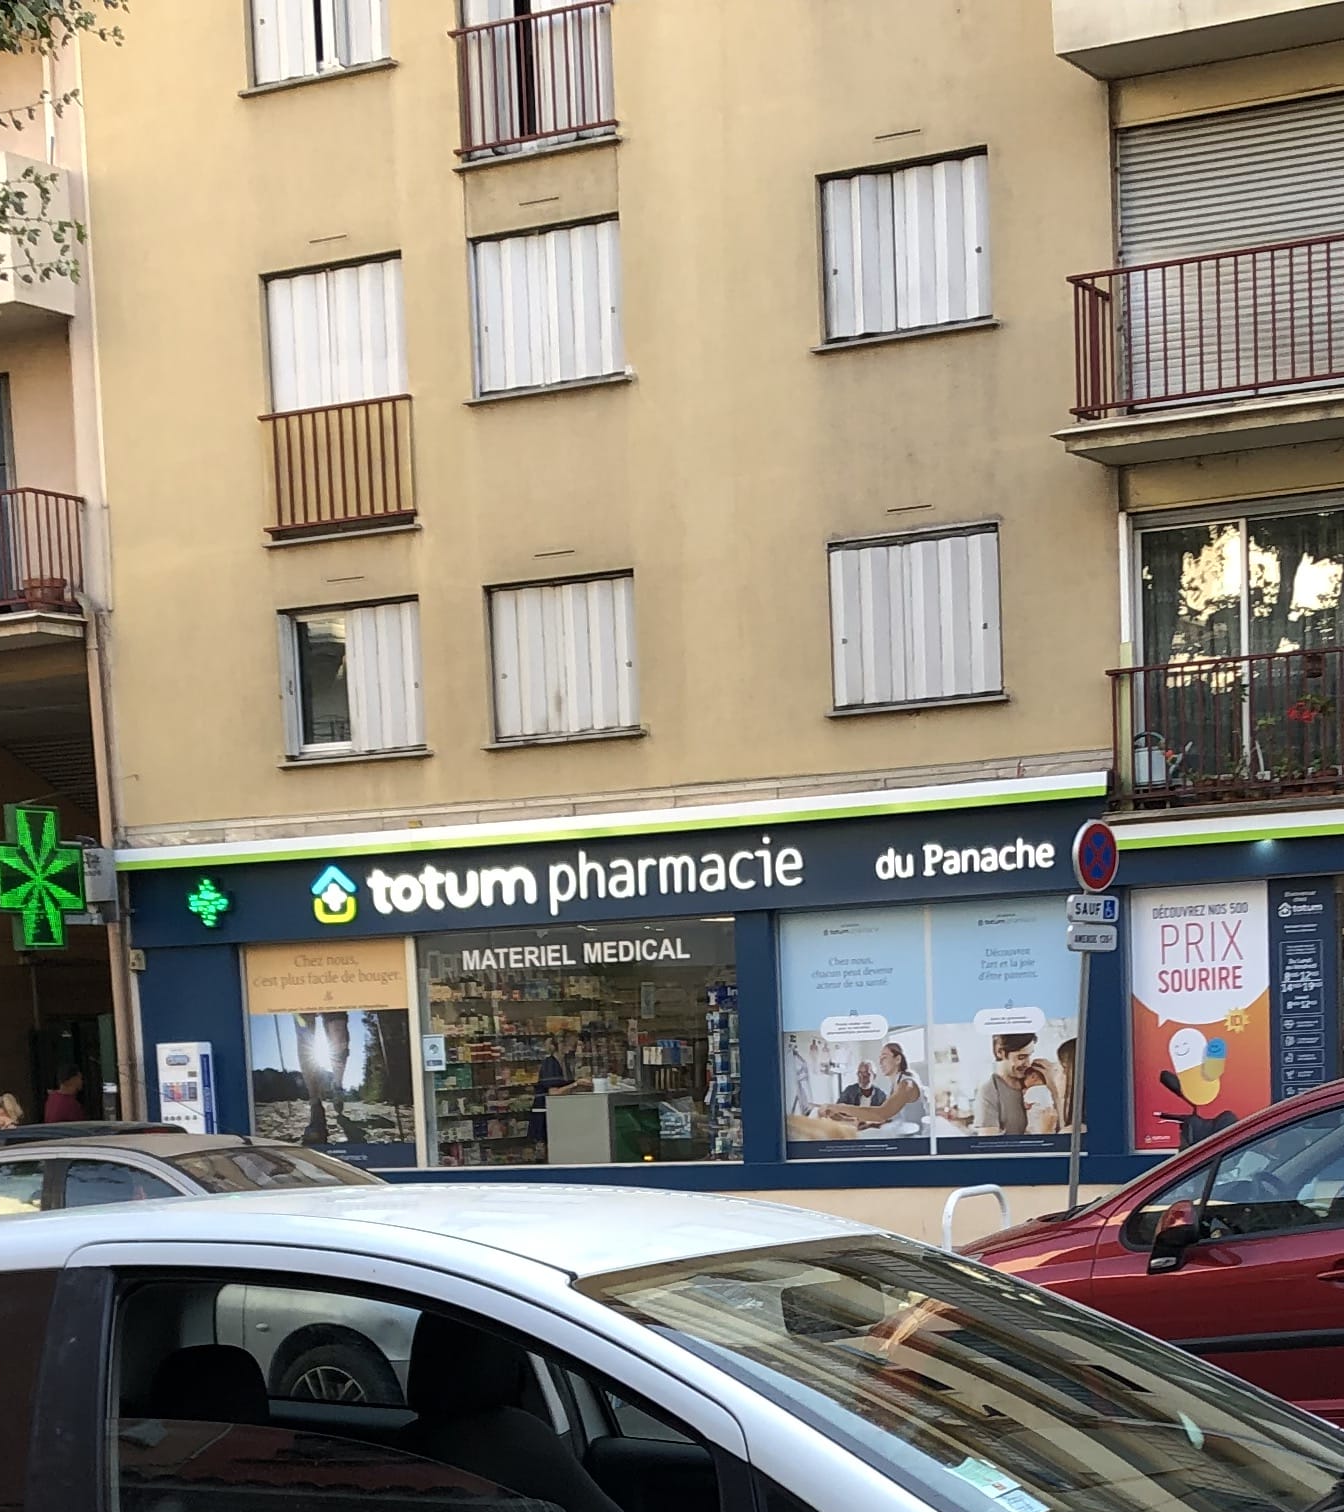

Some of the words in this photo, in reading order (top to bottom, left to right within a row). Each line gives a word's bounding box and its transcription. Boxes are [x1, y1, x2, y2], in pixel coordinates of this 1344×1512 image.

[875, 846, 915, 880] du
[922, 837, 1056, 877] Panache
[366, 864, 537, 914] totum
[549, 835, 803, 915] pharmacie
[1075, 903, 1102, 915] SAUF
[1208, 903, 1227, 915] NOS
[461, 944, 576, 971] MATERIEL
[583, 938, 691, 965] MEDICAL
[1161, 919, 1243, 965] PRIX
[294, 954, 323, 968] Chez
[280, 972, 305, 990] plus
[307, 970, 338, 985] facile
[341, 970, 353, 983] de
[1158, 965, 1243, 993] SOURIRE
